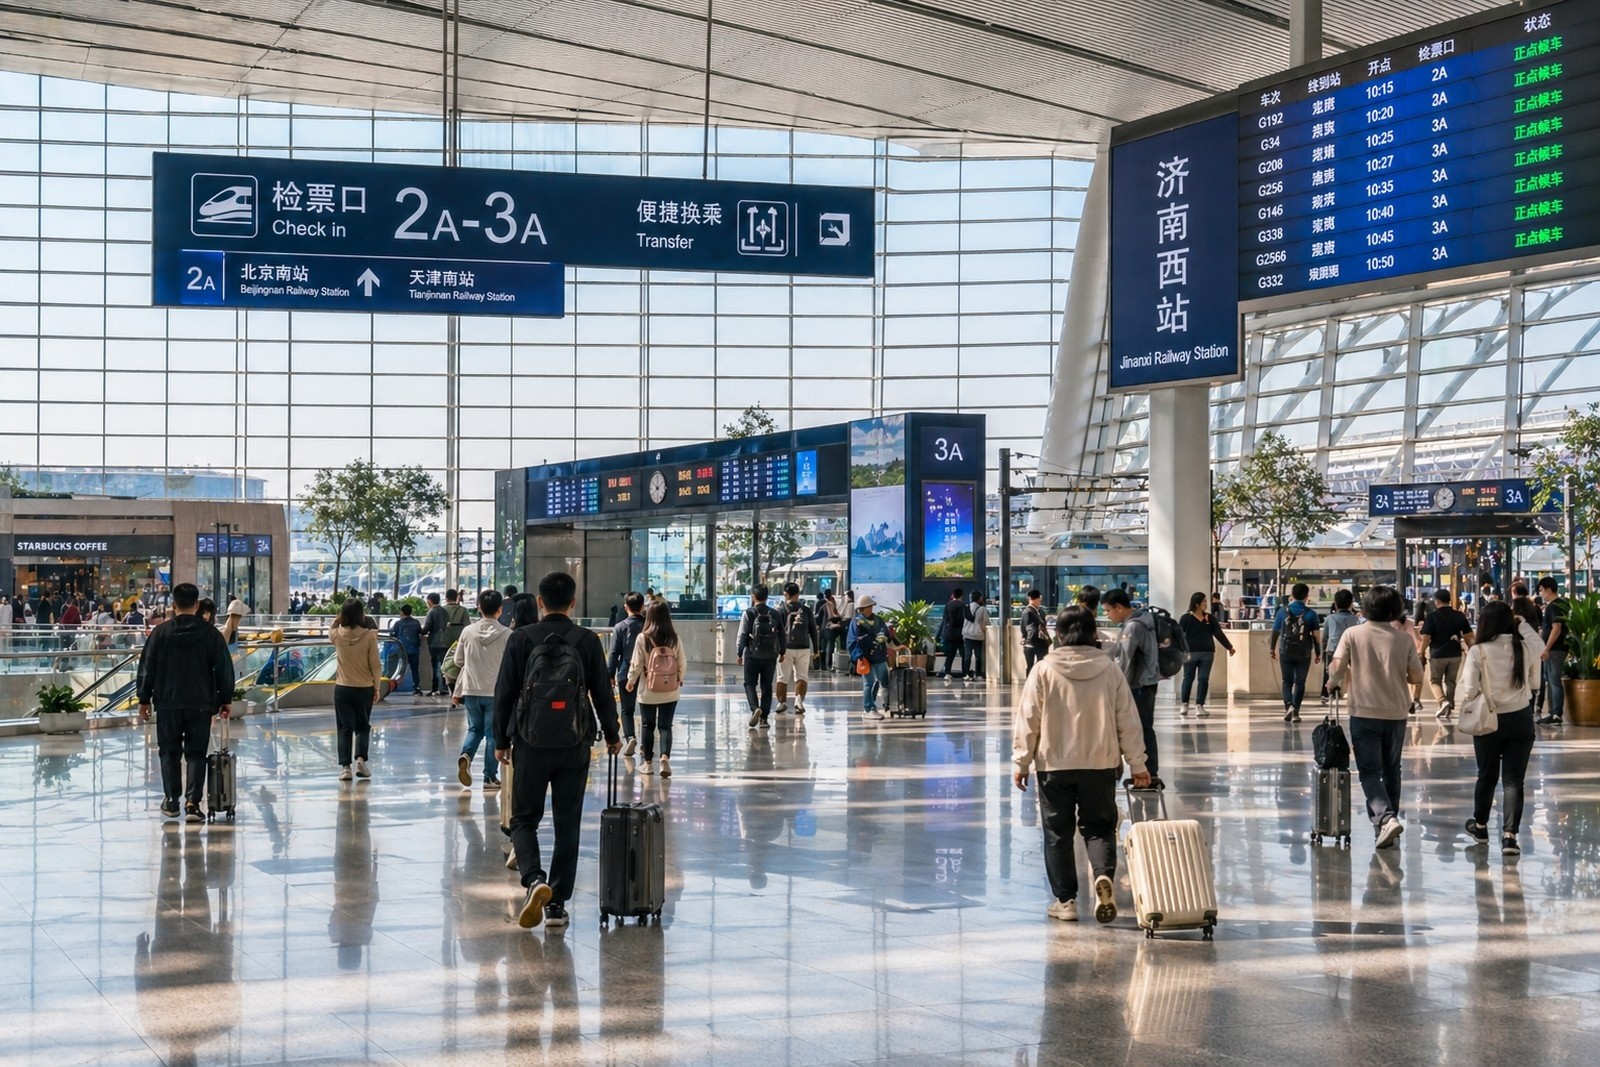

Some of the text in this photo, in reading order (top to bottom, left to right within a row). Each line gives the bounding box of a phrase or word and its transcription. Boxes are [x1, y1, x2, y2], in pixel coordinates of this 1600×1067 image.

[1260, 90, 1281, 107] 车次
[1367, 57, 1392, 77] 开点
[1258, 112, 1284, 129] G192
[1366, 80, 1394, 99] 10:15
[1432, 66, 1448, 82] 2A
[1260, 135, 1281, 151] G34
[1366, 105, 1394, 124] 10:20
[1258, 157, 1283, 174] G208
[1365, 130, 1394, 148] 10:25
[1432, 117, 1448, 132] 3A
[1258, 180, 1284, 197] G256
[1366, 154, 1394, 173] 10:27
[1432, 143, 1448, 158] 3A
[272, 180, 366, 214] 检票口
[1258, 204, 1284, 220] G146
[1365, 179, 1394, 197] 10:35
[1432, 168, 1448, 183] 3A
[636, 199, 722, 226] 便捷换乘
[1258, 227, 1284, 243] G338
[1366, 204, 1394, 222] 10:40
[1432, 194, 1448, 209] 3A
[272, 219, 346, 238] Check in
[636, 232, 694, 249] Transfer
[1156, 155, 1190, 334] 济南西站
[1256, 250, 1287, 266] G2566
[1366, 229, 1394, 246] 10:45
[1432, 220, 1448, 235] 3A
[186, 266, 215, 291] 2A
[240, 263, 309, 282] 北京南站
[409, 269, 475, 287] 天津南站
[1258, 273, 1283, 289] G332
[1366, 254, 1394, 271] 10:50
[1432, 246, 1448, 261] 3A
[286, 285, 319, 298] Railway
[320, 286, 350, 297] Station
[452, 290, 486, 303] Railway
[487, 291, 516, 302] Station
[1119, 343, 1229, 370] Jinanxi Railway Station
[934, 437, 964, 462] 3A
[1505, 488, 1524, 504] 3A
[17, 541, 108, 551] STARBUCKS COFFEE
